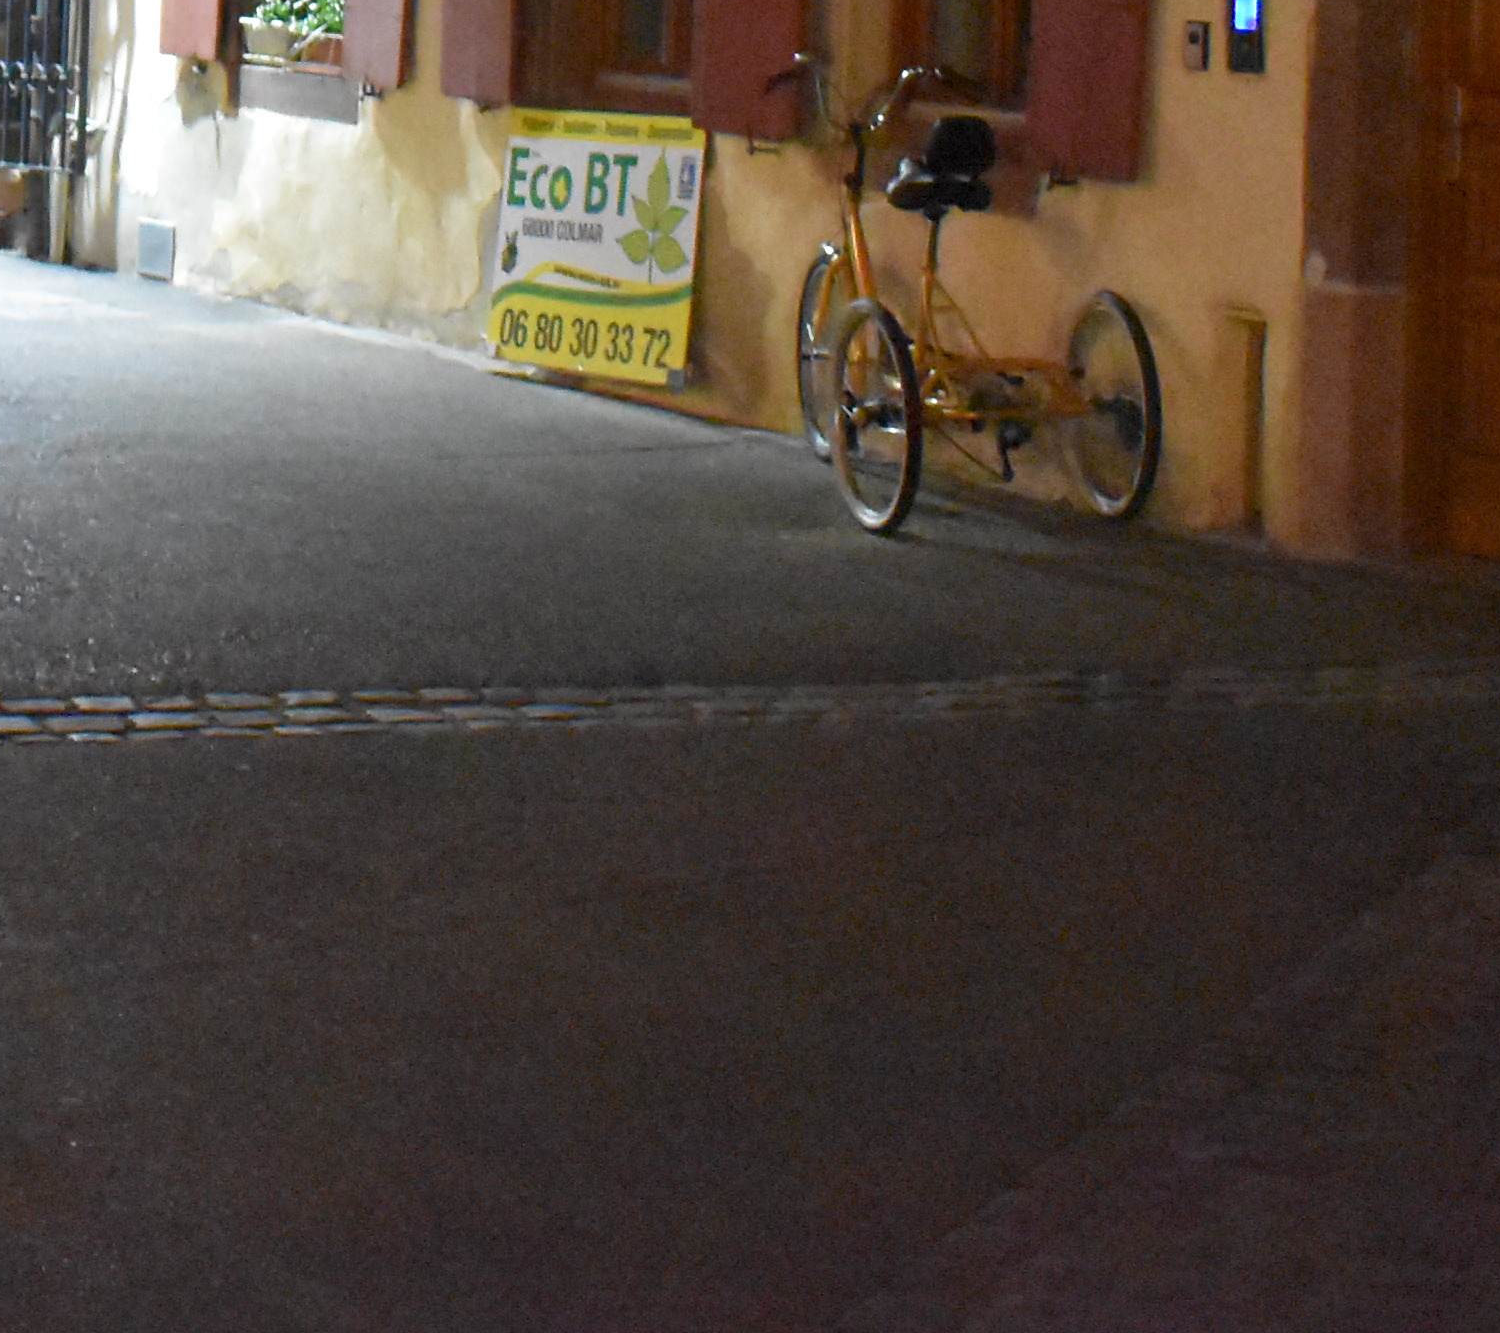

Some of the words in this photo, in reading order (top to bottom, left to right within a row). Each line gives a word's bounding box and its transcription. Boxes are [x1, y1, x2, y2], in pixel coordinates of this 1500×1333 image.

[506, 146, 573, 212] Eco
[584, 151, 639, 217] BT
[556, 219, 604, 244] COLMAR
[499, 307, 529, 348] 06
[534, 312, 565, 354] 80
[568, 317, 599, 360] 30
[605, 320, 634, 364] 33
[641, 325, 671, 369] 72
